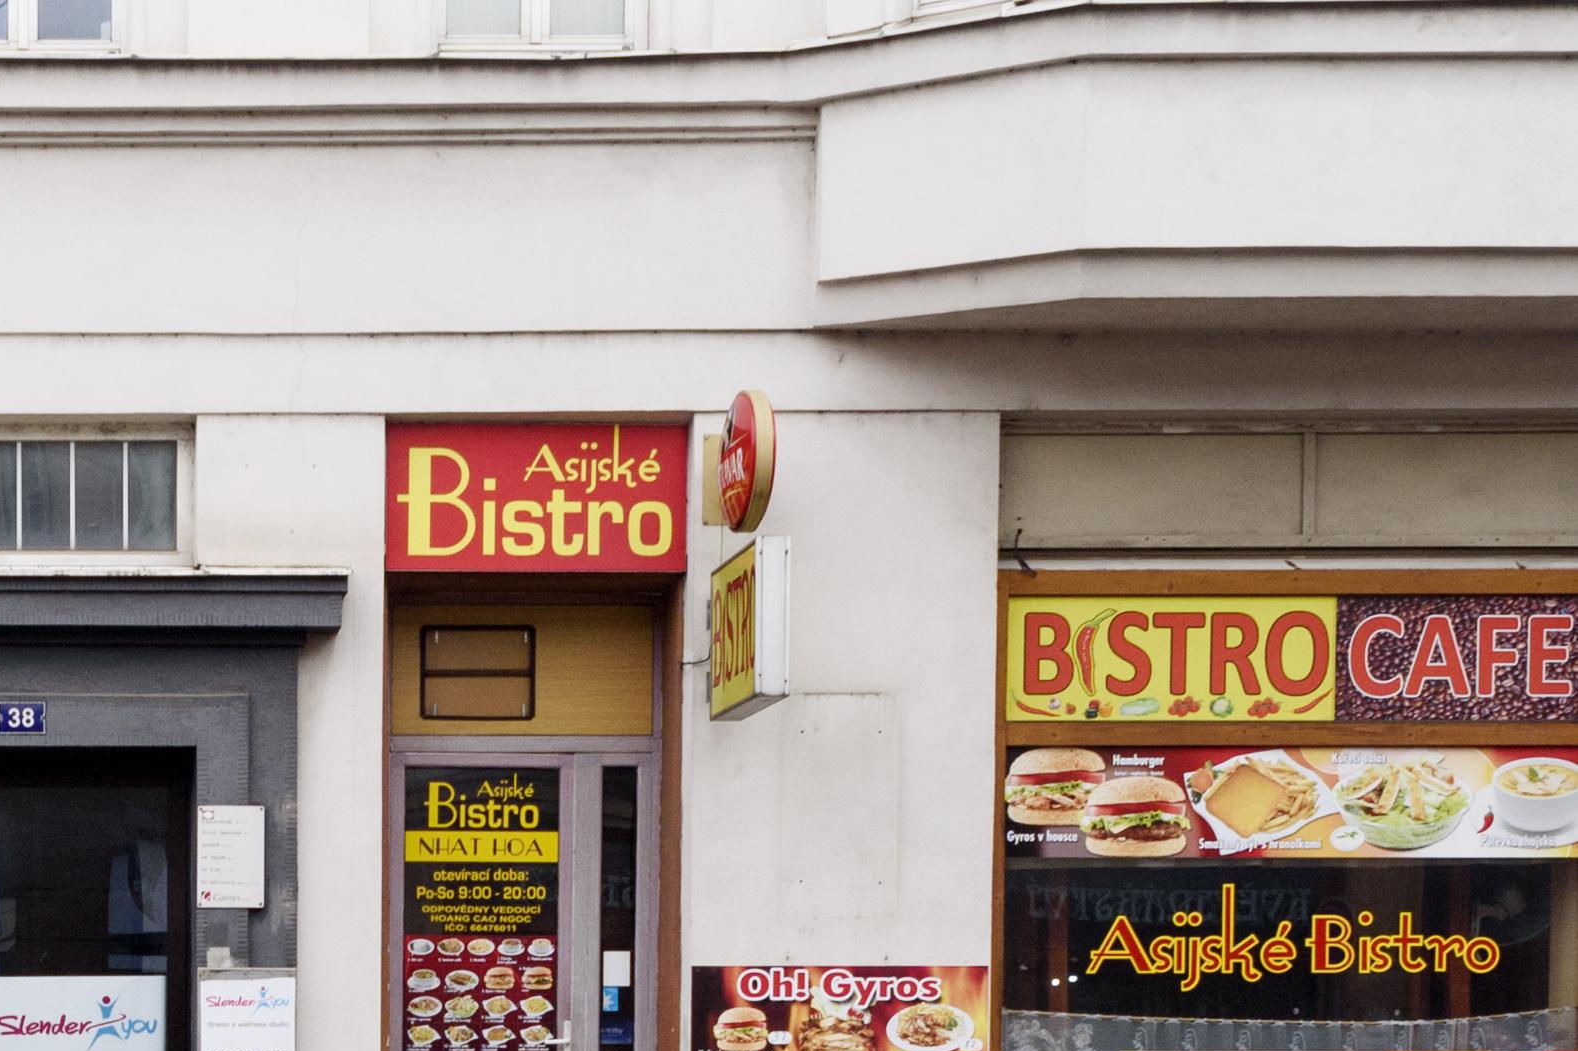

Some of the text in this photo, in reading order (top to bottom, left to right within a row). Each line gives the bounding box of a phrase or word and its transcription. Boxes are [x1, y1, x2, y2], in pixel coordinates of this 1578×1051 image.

[523, 424, 661, 494] Asijské
[396, 446, 673, 557] Bistro
[1022, 607, 1331, 697] BISTRO
[1347, 613, 1577, 700] CAFE
[7, 707, 35, 729] 38
[1112, 754, 1165, 768] Hamburger
[477, 773, 535, 802] Asijské
[423, 781, 540, 829] Bistro
[419, 837, 544, 857] NHAT HOA
[1006, 830, 1078, 844] Gyros v housce
[433, 868, 529, 882] otevírací doba:
[416, 886, 455, 900] Po-So
[458, 886, 492, 900] 9:00
[503, 886, 547, 900] 20:00
[430, 914, 532, 924] HOANG CAO NGOC
[492, 904, 542, 914] VEDOUCÍ
[444, 922, 467, 933] IČO:
[1085, 883, 1501, 993] Asijské Bistro
[738, 967, 942, 1009] Oh! Gyros
[205, 995, 255, 1008] Slender
[121, 1018, 158, 1040] you
